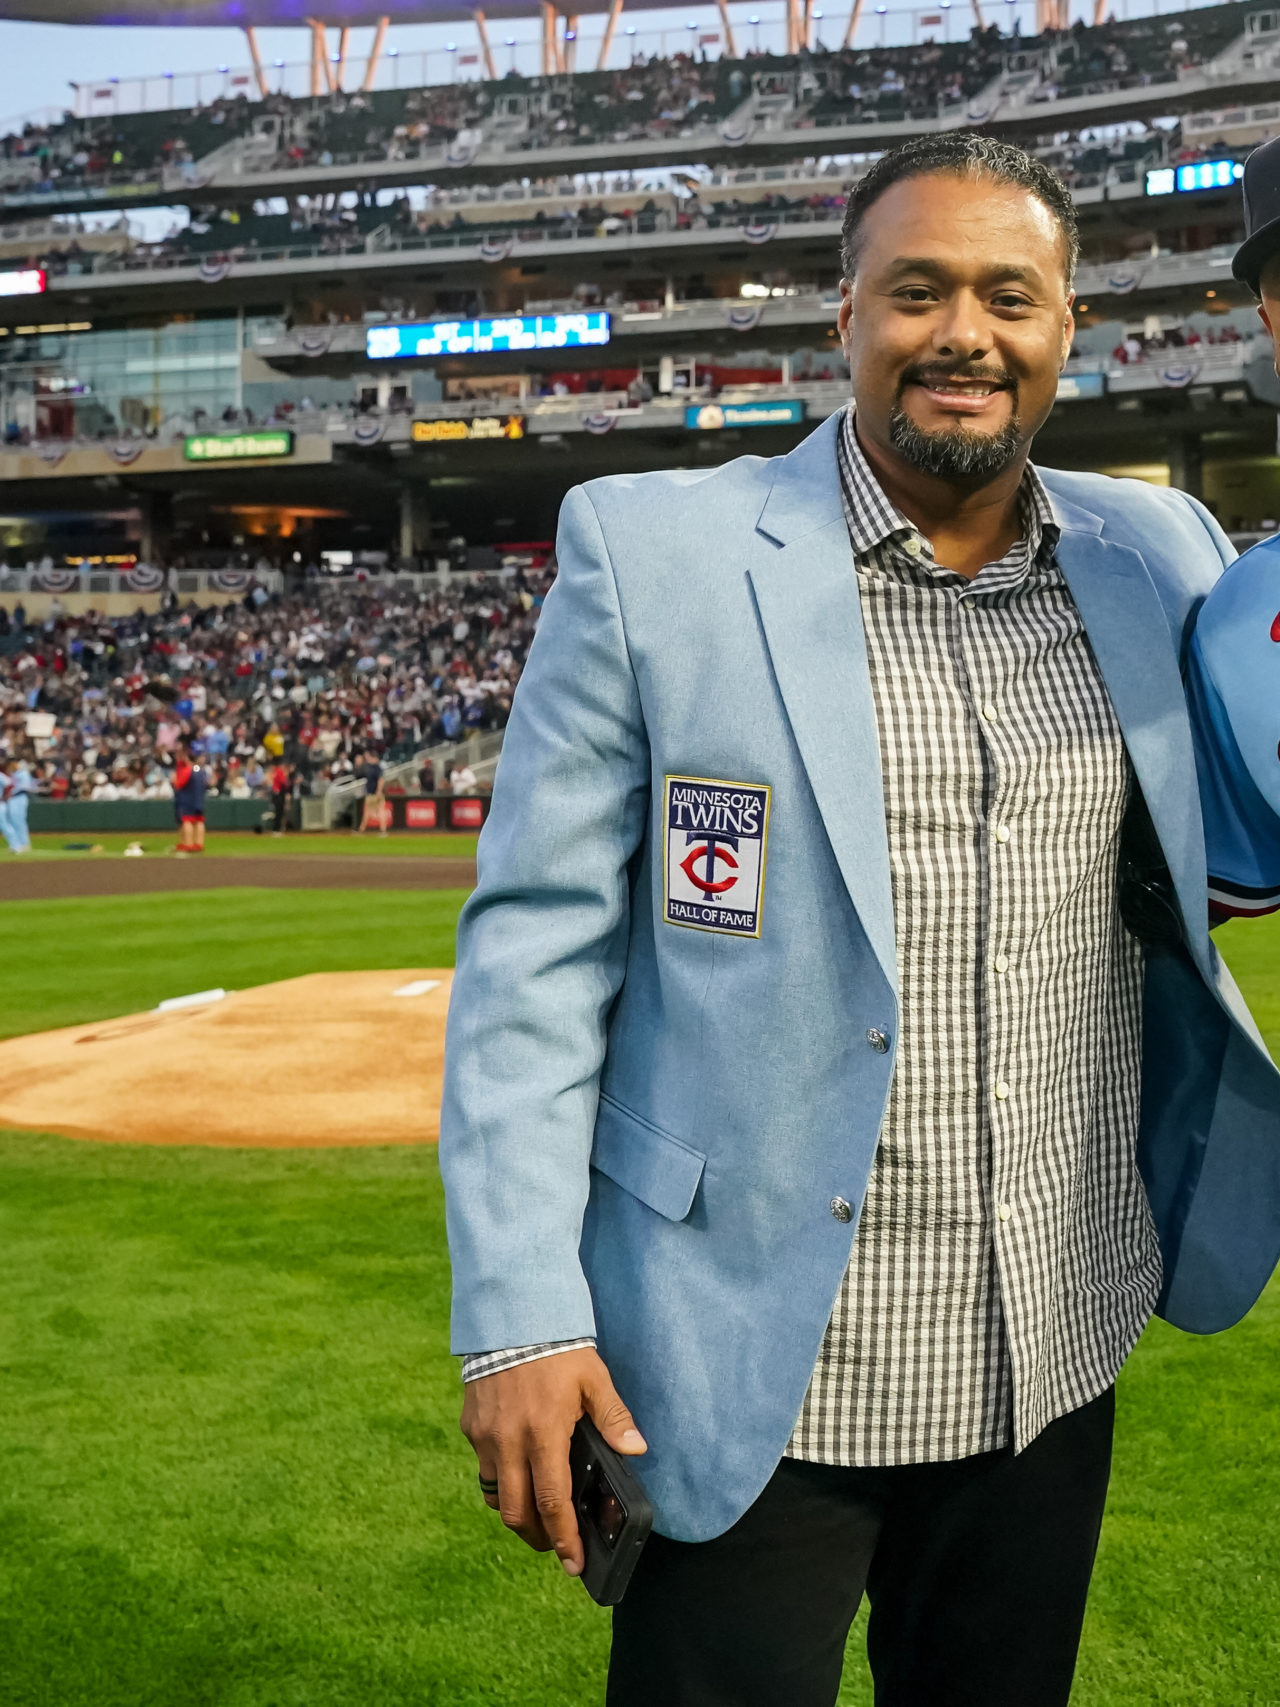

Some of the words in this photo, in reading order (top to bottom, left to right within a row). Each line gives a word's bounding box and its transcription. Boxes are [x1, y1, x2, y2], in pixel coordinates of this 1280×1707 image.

[672, 788, 762, 811] MINNESOTA
[672, 801, 759, 834] TWINS
[670, 903, 699, 920] HALL
[702, 908, 718, 922] OF
[719, 911, 754, 928] FAME
